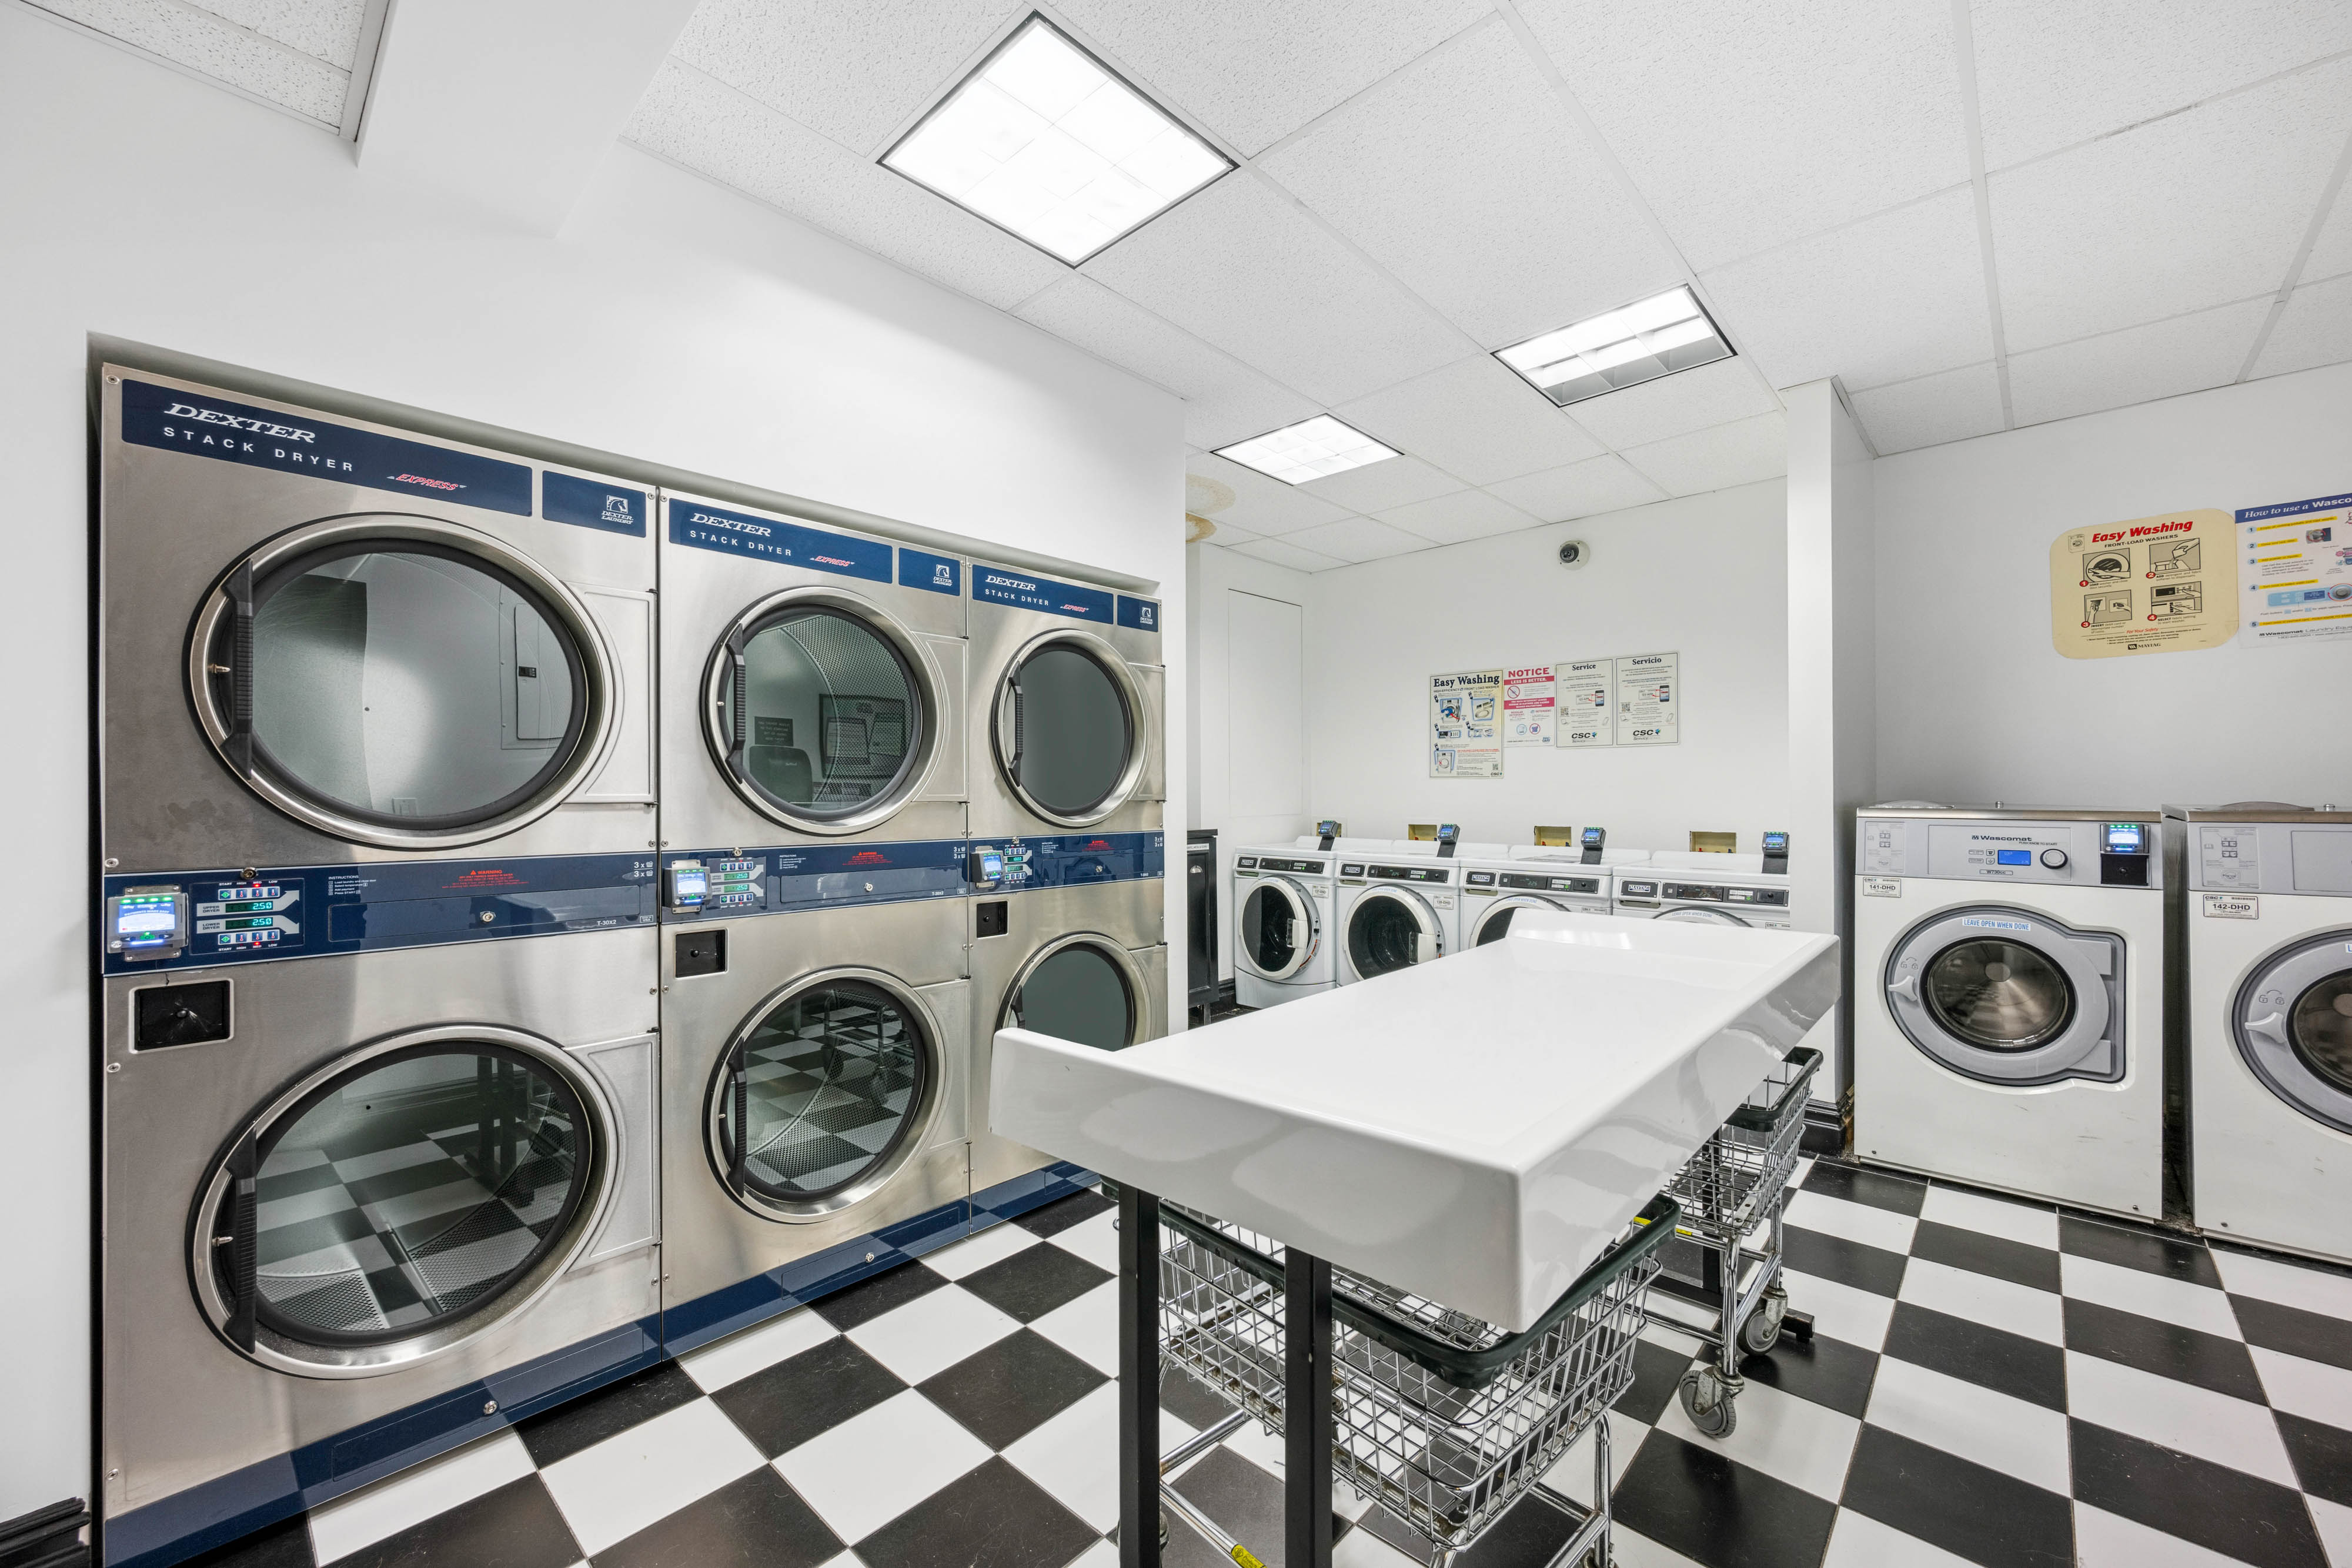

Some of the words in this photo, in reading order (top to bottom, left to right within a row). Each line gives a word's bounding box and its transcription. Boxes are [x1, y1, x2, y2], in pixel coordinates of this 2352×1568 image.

[163, 403, 316, 443] DEXTER
[163, 427, 254, 453] STACK
[275, 449, 353, 472] DRYER
[395, 474, 459, 491] EXPRESS
[2244, 509, 2269, 519] How
[690, 513, 771, 537] DEXTER
[2092, 530, 2127, 543] Easy
[2129, 520, 2193, 537] Washing
[690, 530, 739, 547] STACK
[749, 541, 792, 557] DRYER
[2104, 539, 2144, 548] FRONT-LOAD
[2145, 534, 2179, 542] WASHERS
[814, 555, 851, 567] EXPRESS
[985, 575, 1036, 591] DEXTER
[985, 589, 1015, 600] STACK
[1021, 596, 1049, 606] DRYER
[1063, 604, 1087, 612] EXPRESS
[1632, 657, 1662, 665] Servicio
[1508, 667, 1550, 678] NOTICE
[1434, 678, 1455, 688] Easy
[1457, 674, 1500, 685] Washing
